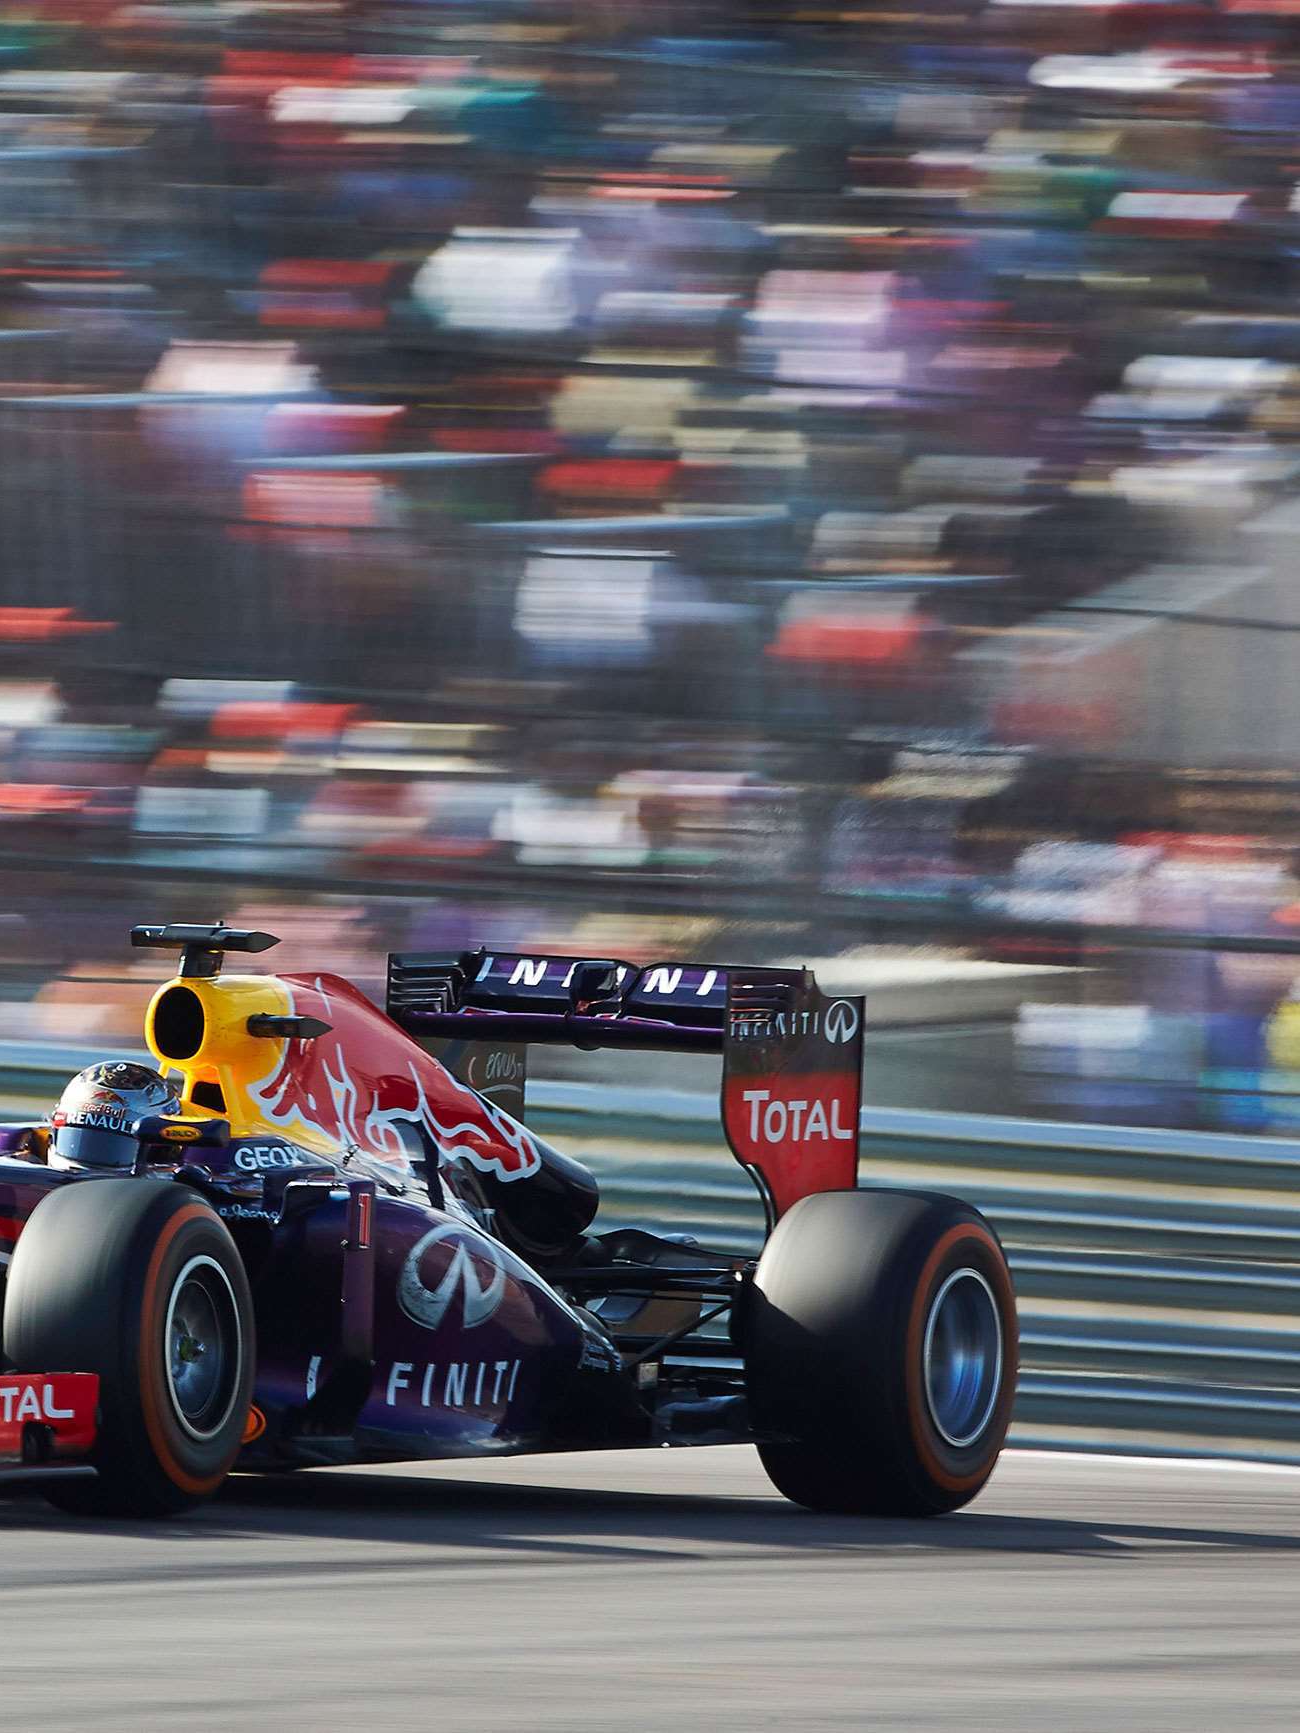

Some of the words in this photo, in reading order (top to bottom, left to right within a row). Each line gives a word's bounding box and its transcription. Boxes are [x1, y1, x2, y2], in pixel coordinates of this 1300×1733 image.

[743, 1090, 853, 1143] TOTAL
[235, 1147, 303, 1171] GEOX
[306, 1355, 522, 1407] IFINITI
